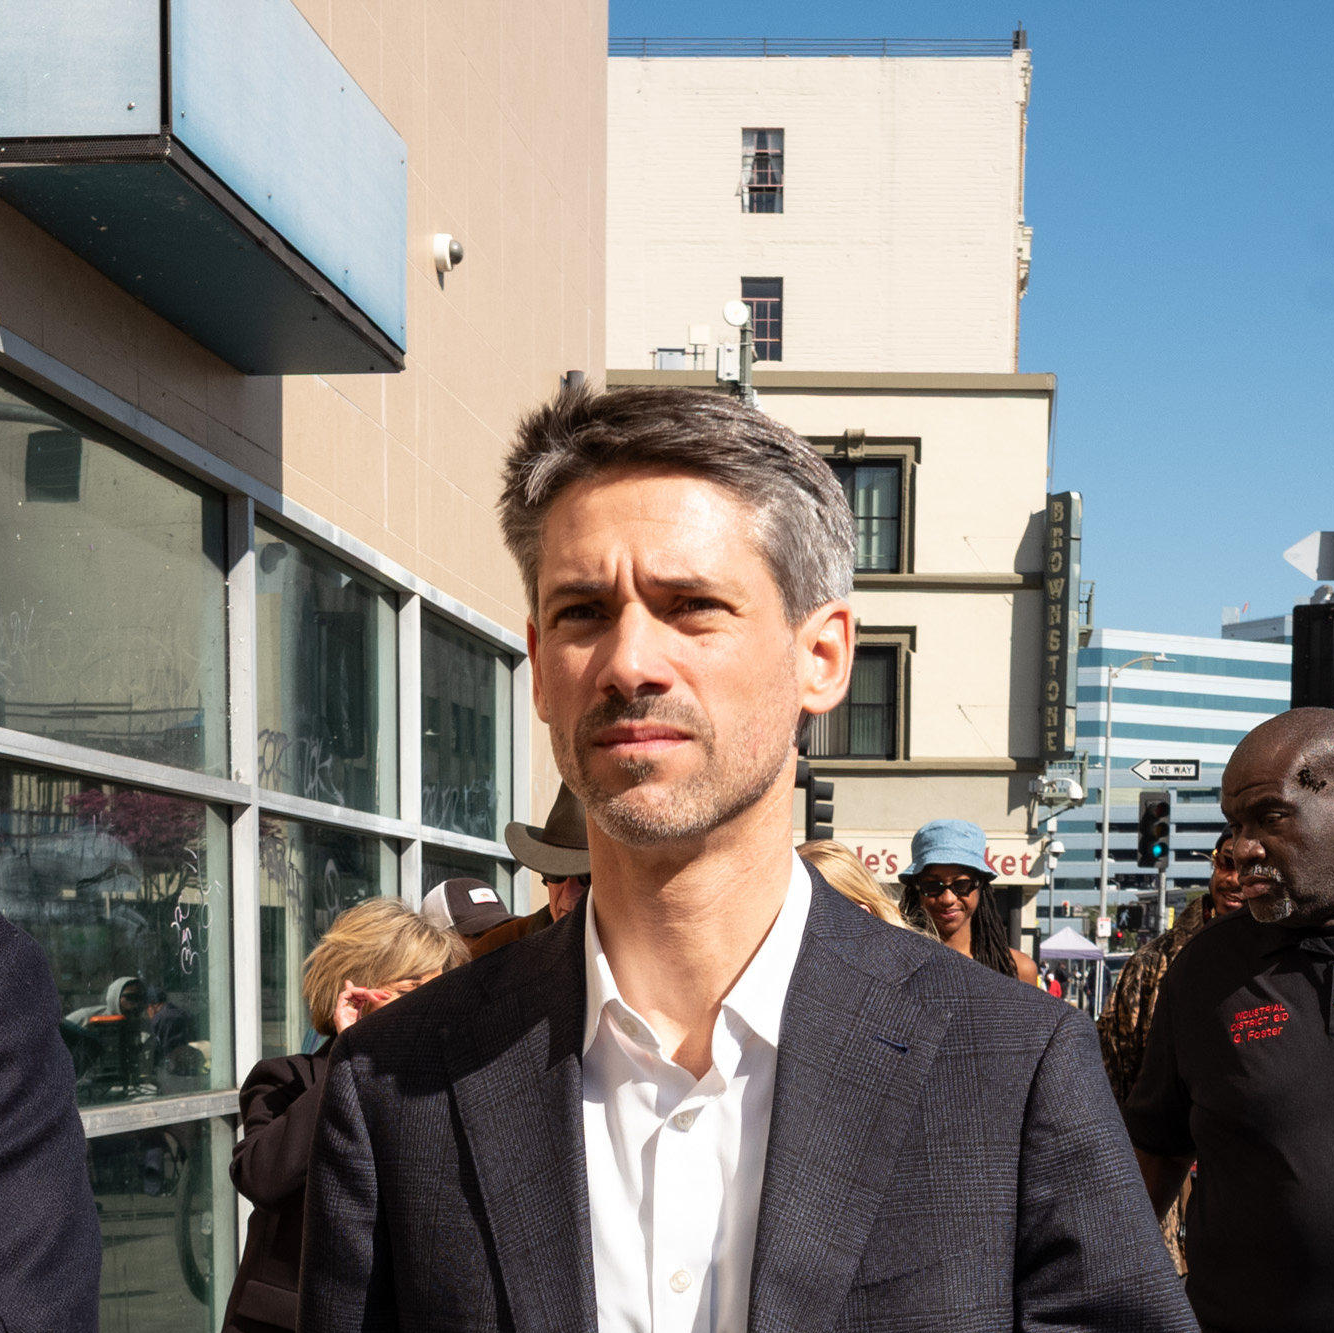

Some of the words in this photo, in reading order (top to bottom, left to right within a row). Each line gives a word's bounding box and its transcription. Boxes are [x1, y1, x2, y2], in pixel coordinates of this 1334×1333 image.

[1045, 501, 1065, 752] BROWNSTONE
[1151, 765, 1170, 775] ONE
[1174, 766, 1193, 775] WAY
[1248, 1026, 1283, 1041] Foster
